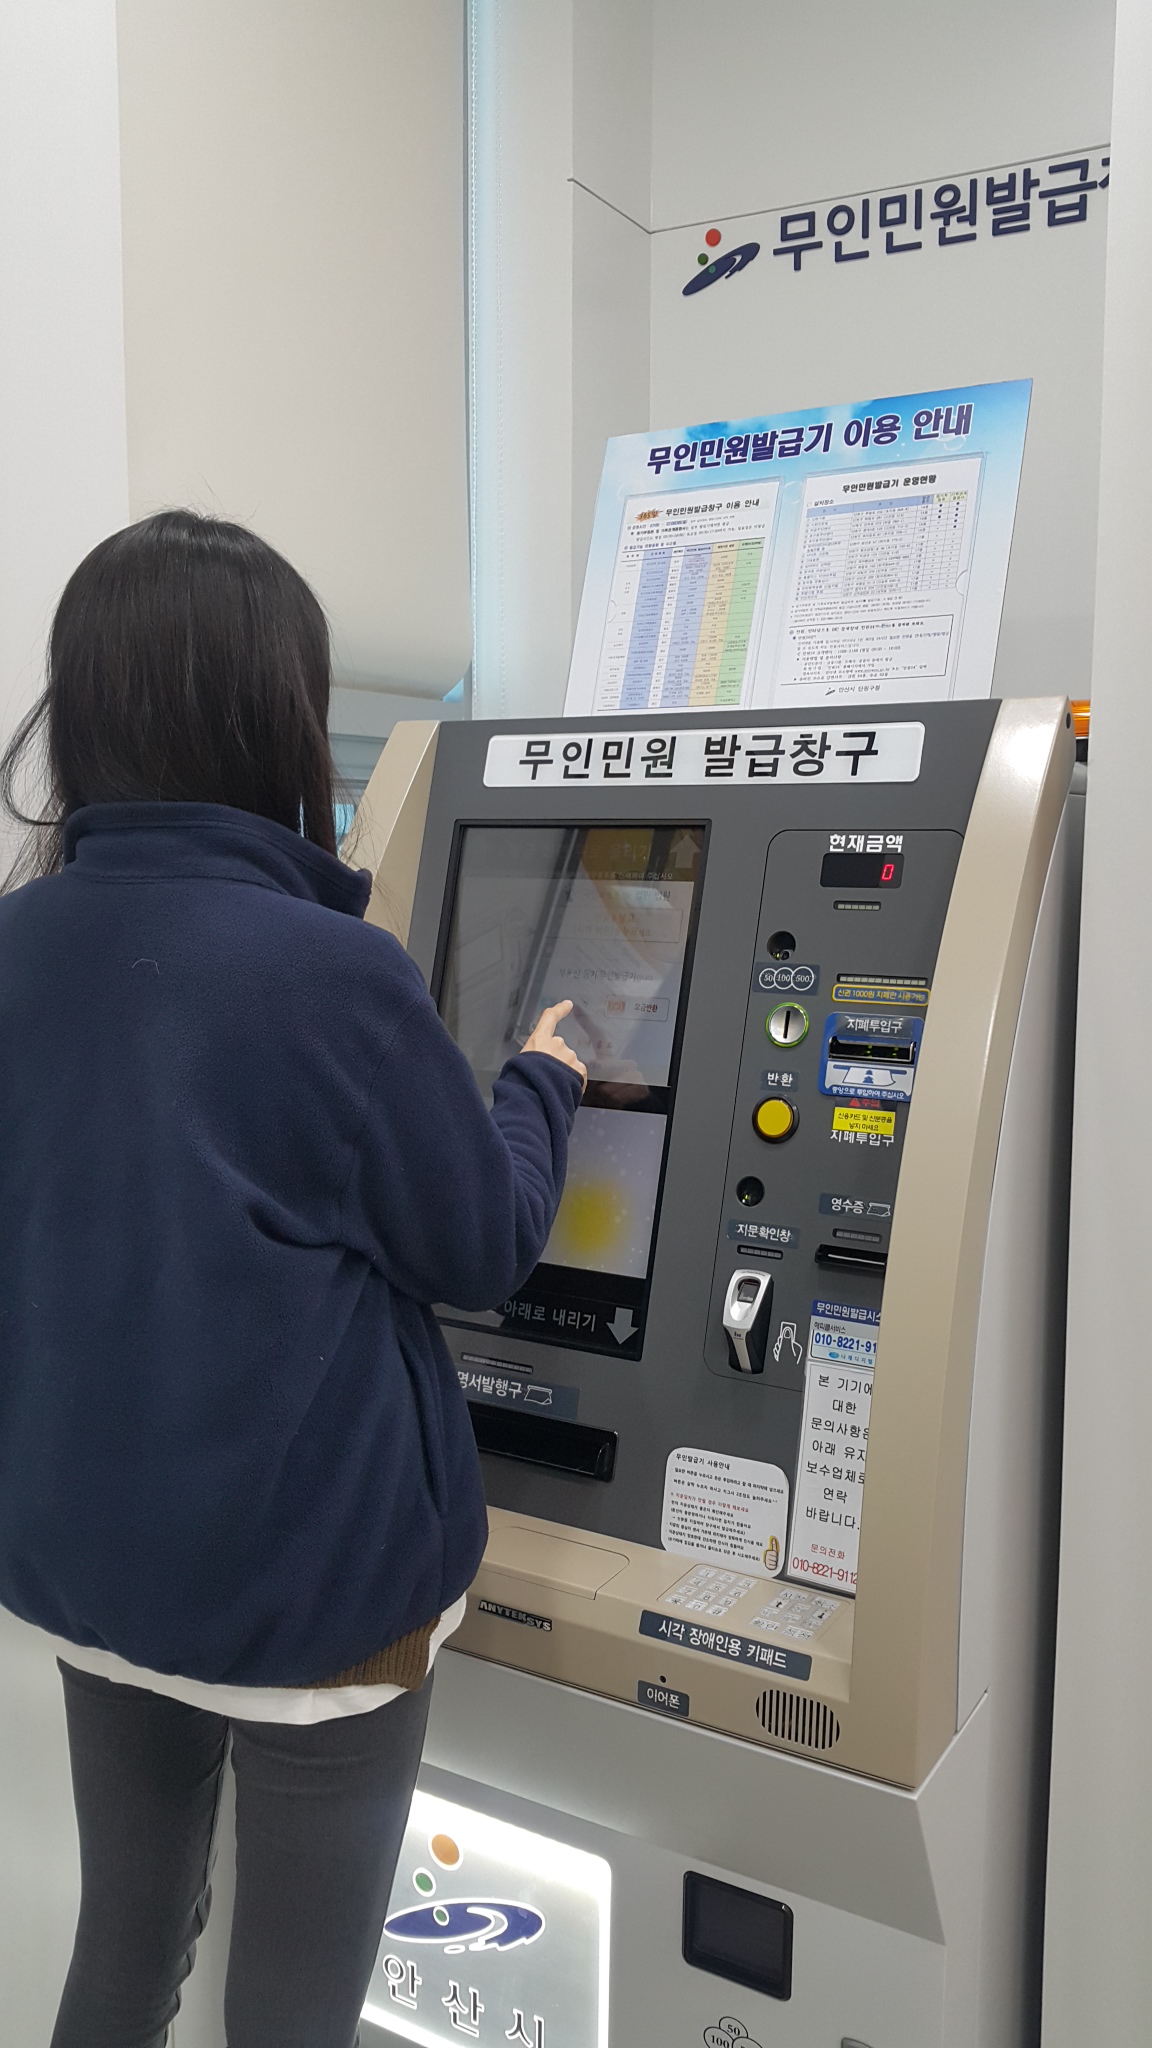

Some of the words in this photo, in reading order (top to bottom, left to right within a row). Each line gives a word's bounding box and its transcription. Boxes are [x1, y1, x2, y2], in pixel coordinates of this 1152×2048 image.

[773, 157, 1110, 271] 무인민원발급
[646, 422, 833, 476] 무인민원발급기
[843, 413, 901, 448] 이용
[912, 402, 974, 440] 안내
[842, 478, 899, 493] 무인민원발급기
[665, 502, 723, 517] 무인민원발급창구
[726, 500, 741, 510] 이용
[744, 498, 760, 508] 안내
[518, 735, 677, 781] 무인민원
[703, 730, 880, 778] 발급창구
[829, 834, 904, 853] 현재금액
[881, 864, 895, 881] 0
[852, 989, 875, 998] 1000원
[847, 1018, 903, 1034] 지폐투입구
[767, 1072, 793, 1087] 반환
[832, 1086, 855, 1095] 중앙으로
[857, 1088, 880, 1097] 투입하여
[881, 1091, 904, 1099] 주십시오
[861, 1098, 881, 1108] 주의
[838, 1112, 861, 1121] 신용카드
[862, 1123, 879, 1131] 마세요
[830, 1129, 894, 1147] 지폐투입구
[831, 1197, 865, 1214] 영수증
[737, 1223, 792, 1242] 지문확인창
[504, 1300, 546, 1322] 아래로
[552, 1307, 597, 1332] 내리기
[818, 1374, 830, 1388] 본
[832, 1399, 857, 1415] 대한
[812, 1440, 836, 1456] 아래
[676, 1453, 704, 1465] 무인발급기
[707, 1460, 731, 1471] 사용안내
[823, 1487, 848, 1504] 연락
[805, 1506, 860, 1530] 바랍니다.
[810, 1543, 845, 1560] 문의전화
[480, 1601, 552, 1631] ANYTEKSYS
[658, 1619, 685, 1641] 시각
[689, 1627, 742, 1657] 장애인용
[746, 1644, 787, 1669] 키패드
[646, 1687, 681, 1710] 이어폰
[726, 2024, 741, 2037] 50
[710, 2034, 730, 2048] 100
